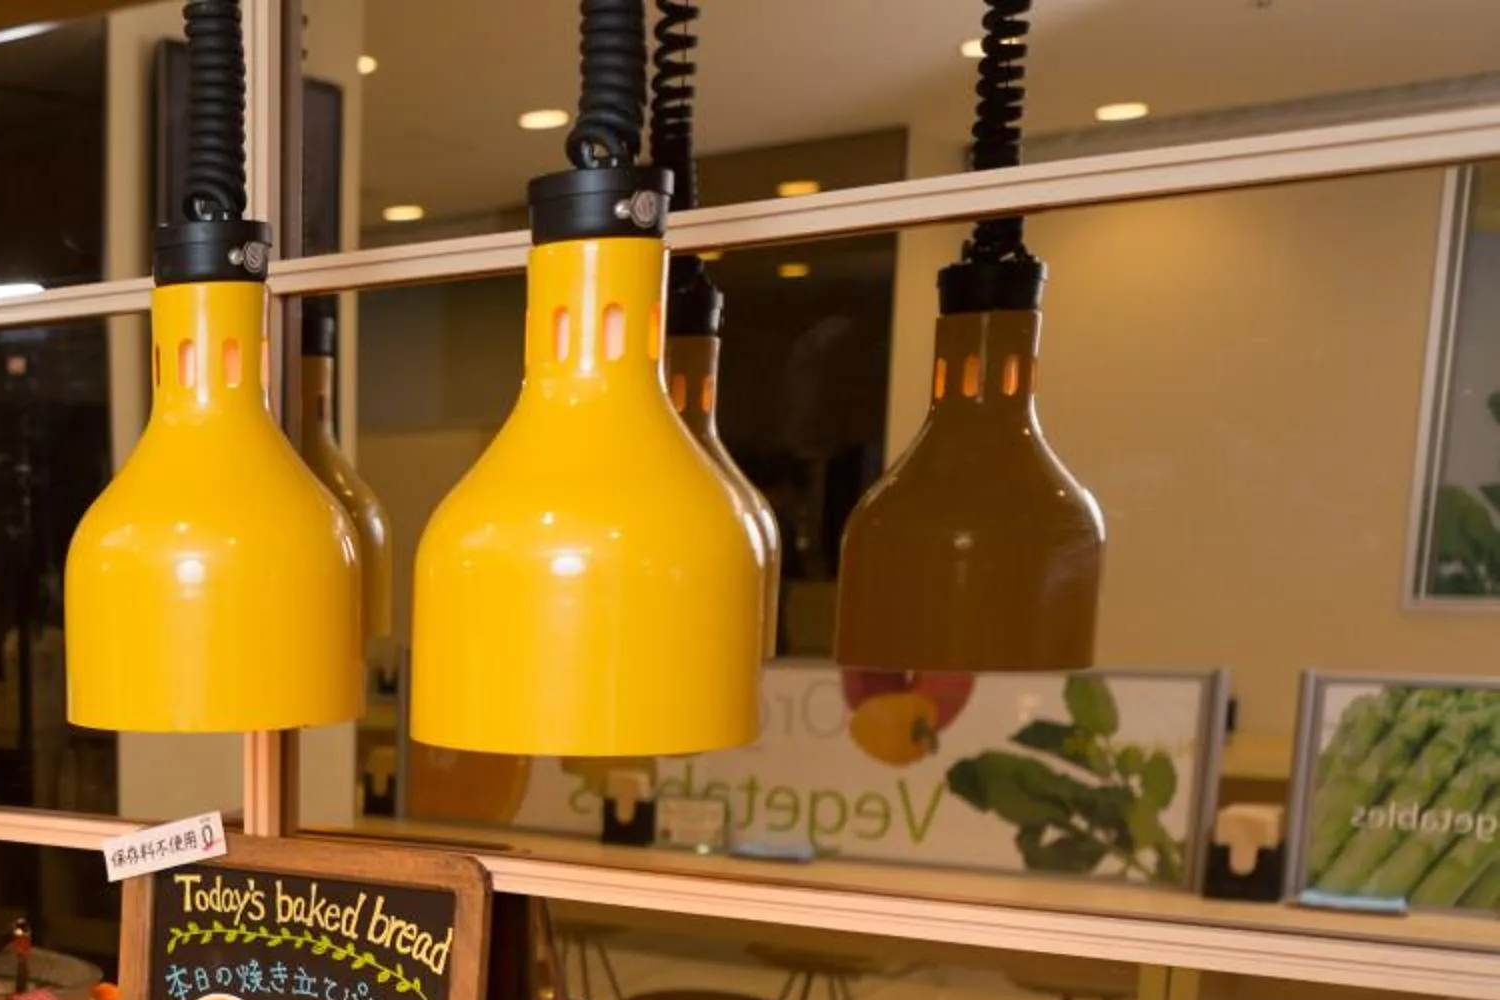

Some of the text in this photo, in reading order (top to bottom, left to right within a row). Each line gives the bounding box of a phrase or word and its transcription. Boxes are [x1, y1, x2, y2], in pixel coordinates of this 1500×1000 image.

[111, 829, 198, 867] 保存料不使用
[174, 873, 455, 976] Today's baked bread
